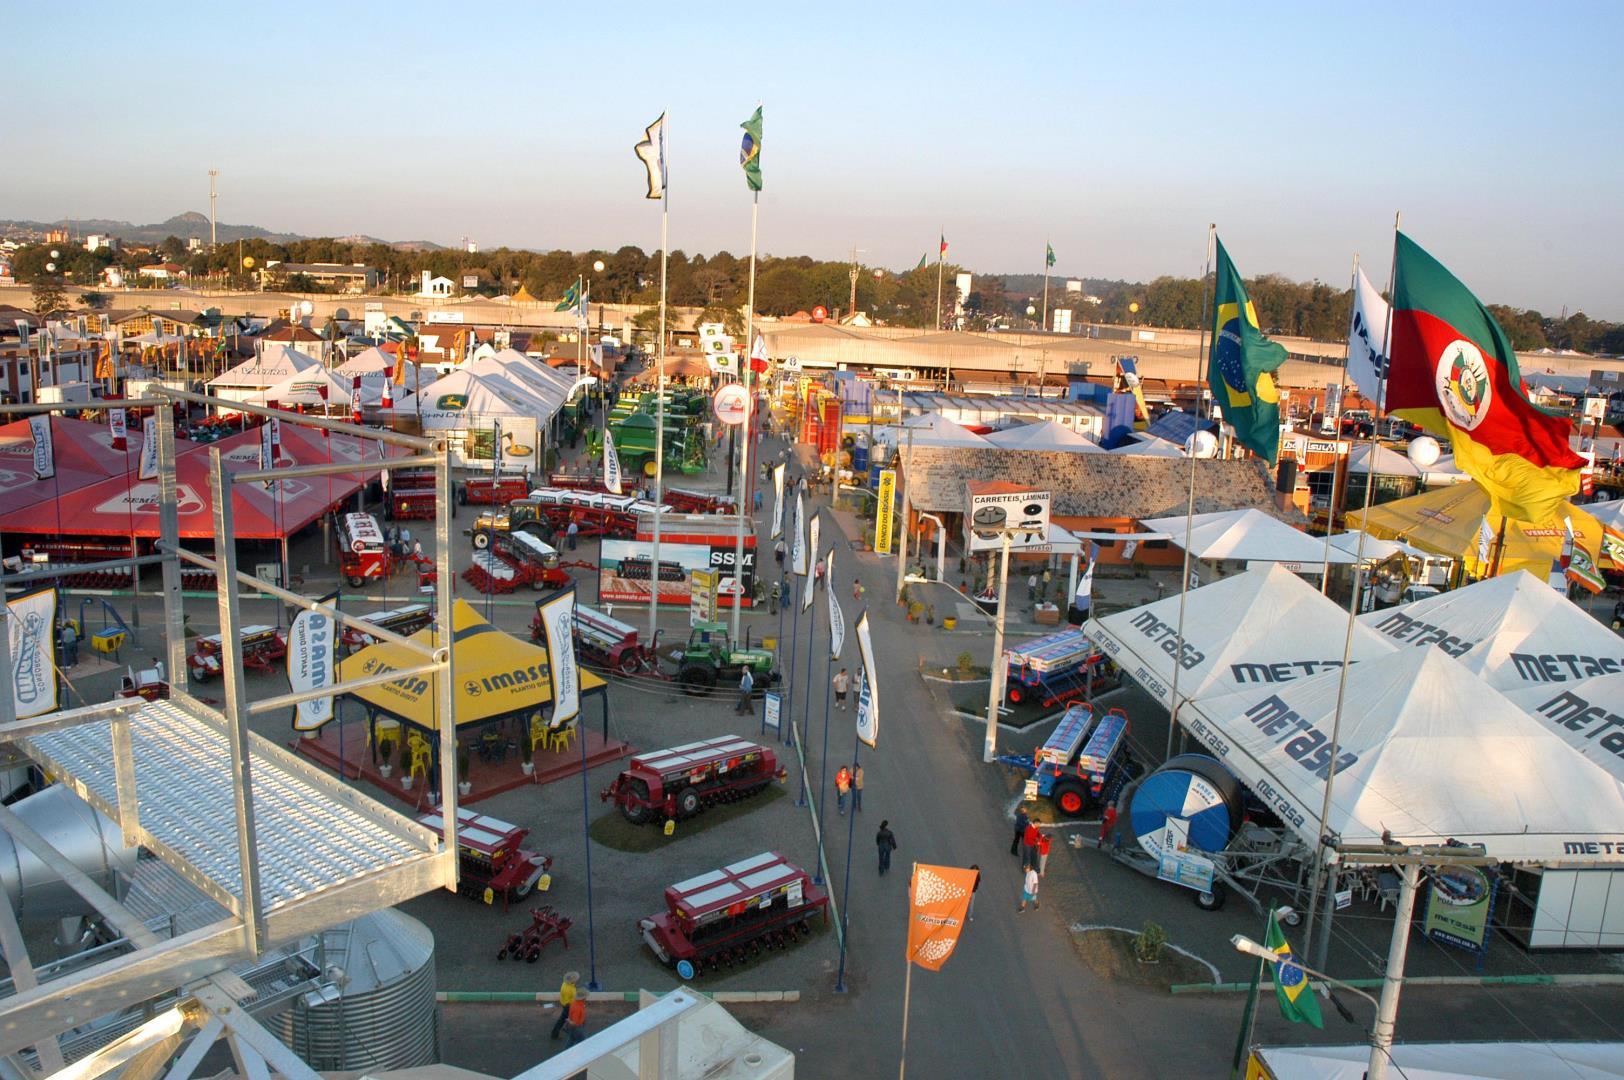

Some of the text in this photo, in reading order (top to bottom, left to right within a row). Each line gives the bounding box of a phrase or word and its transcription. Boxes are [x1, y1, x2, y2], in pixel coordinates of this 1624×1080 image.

[880, 524, 888, 549] BANCO
[884, 513, 889, 524] DO
[711, 552, 754, 566] SSM
